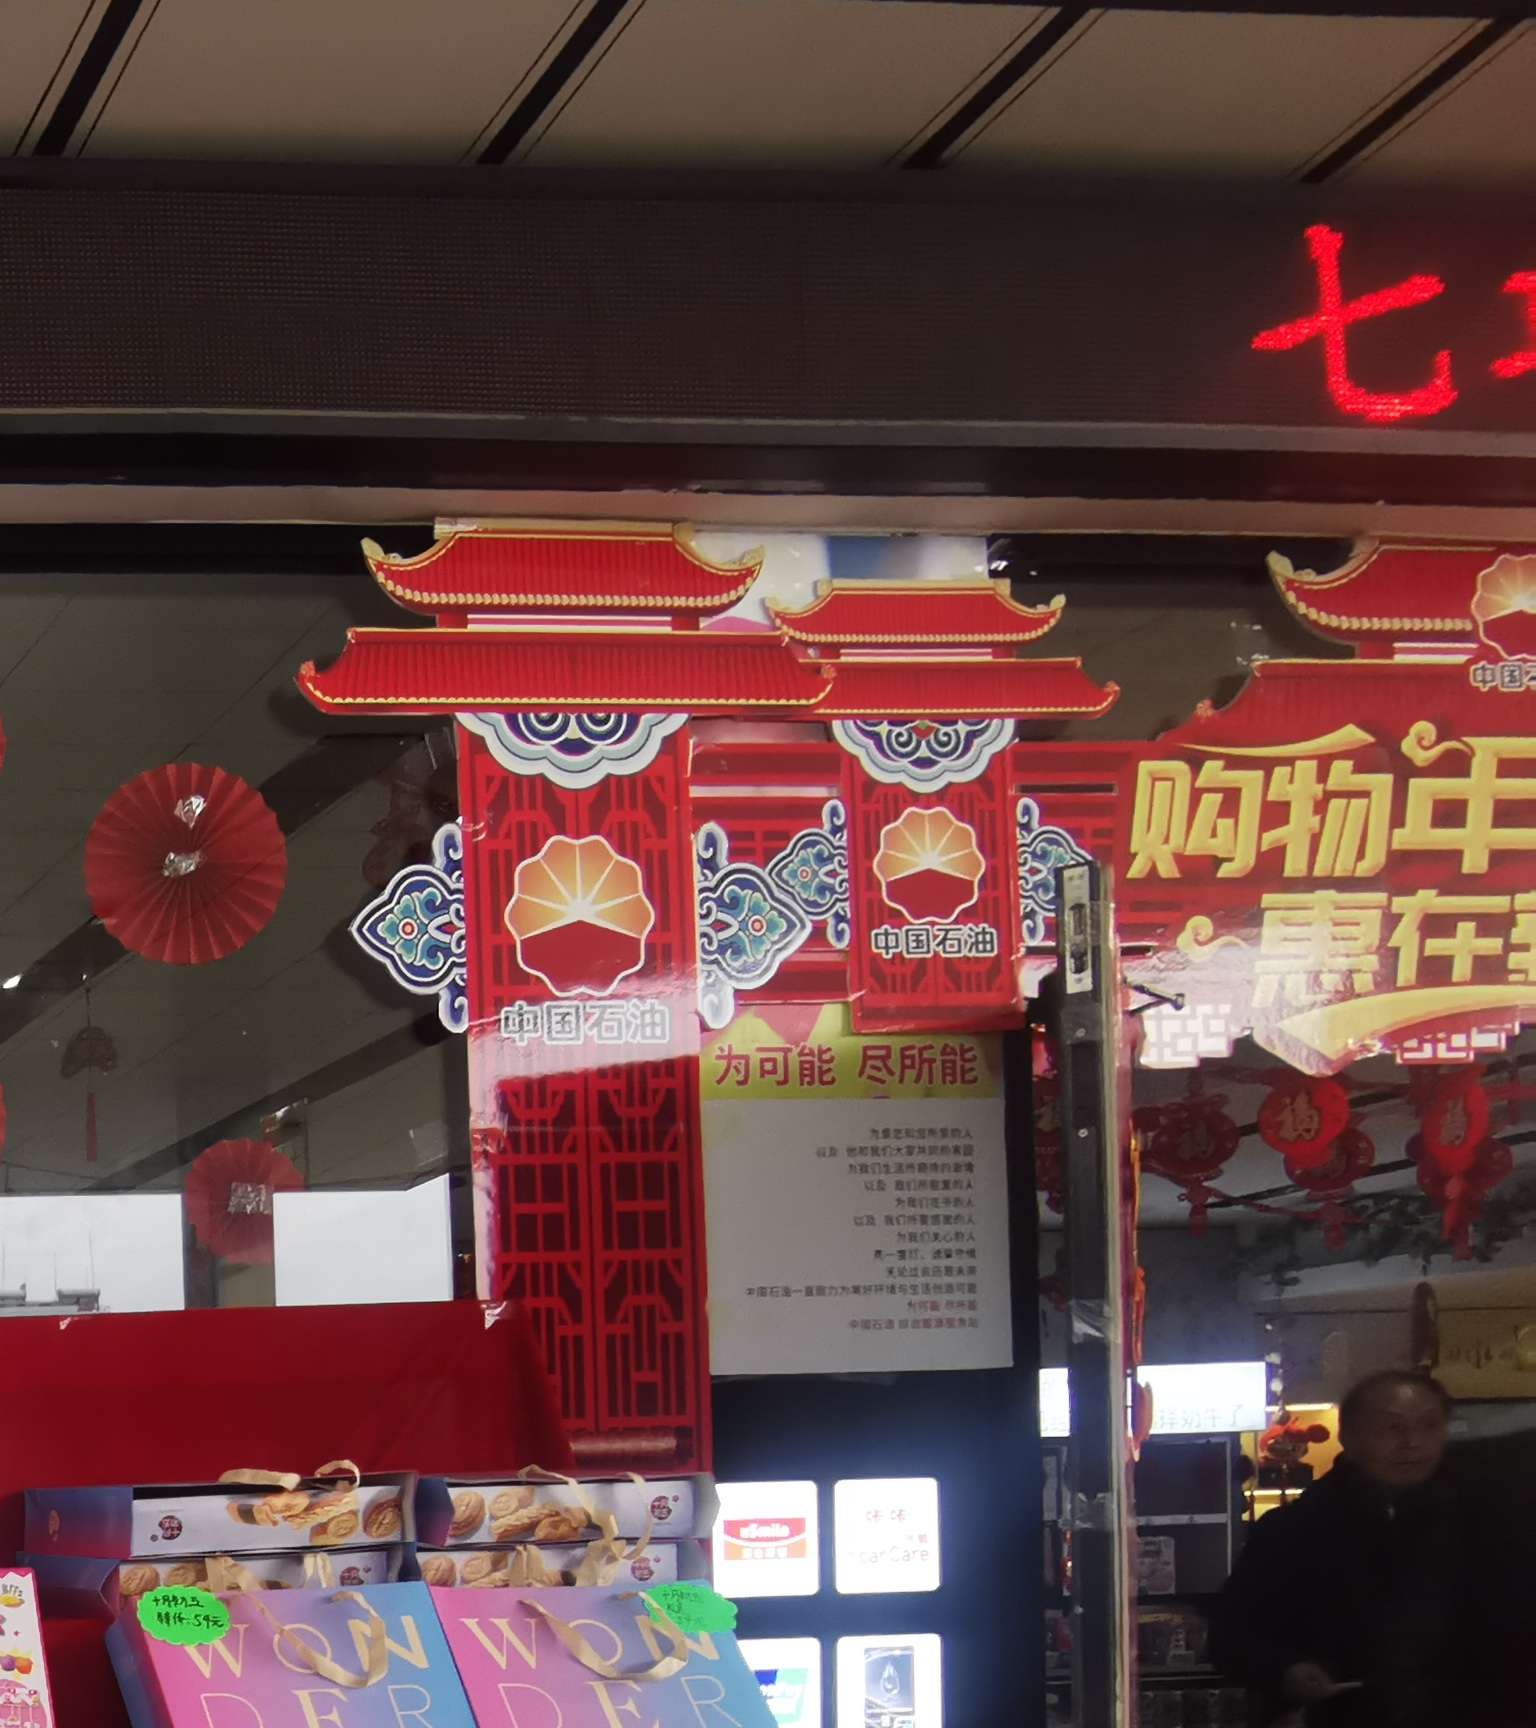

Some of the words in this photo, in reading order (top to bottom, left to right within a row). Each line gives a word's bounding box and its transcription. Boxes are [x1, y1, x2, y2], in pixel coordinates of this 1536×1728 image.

[1471, 661, 1536, 693] 中国
[870, 927, 997, 959] 中国石油
[1251, 889, 1536, 1009] 惠在
[499, 1000, 673, 1045] 中国石油
[714, 1043, 837, 1087] 为可能
[858, 1042, 979, 1087] 尽所能
